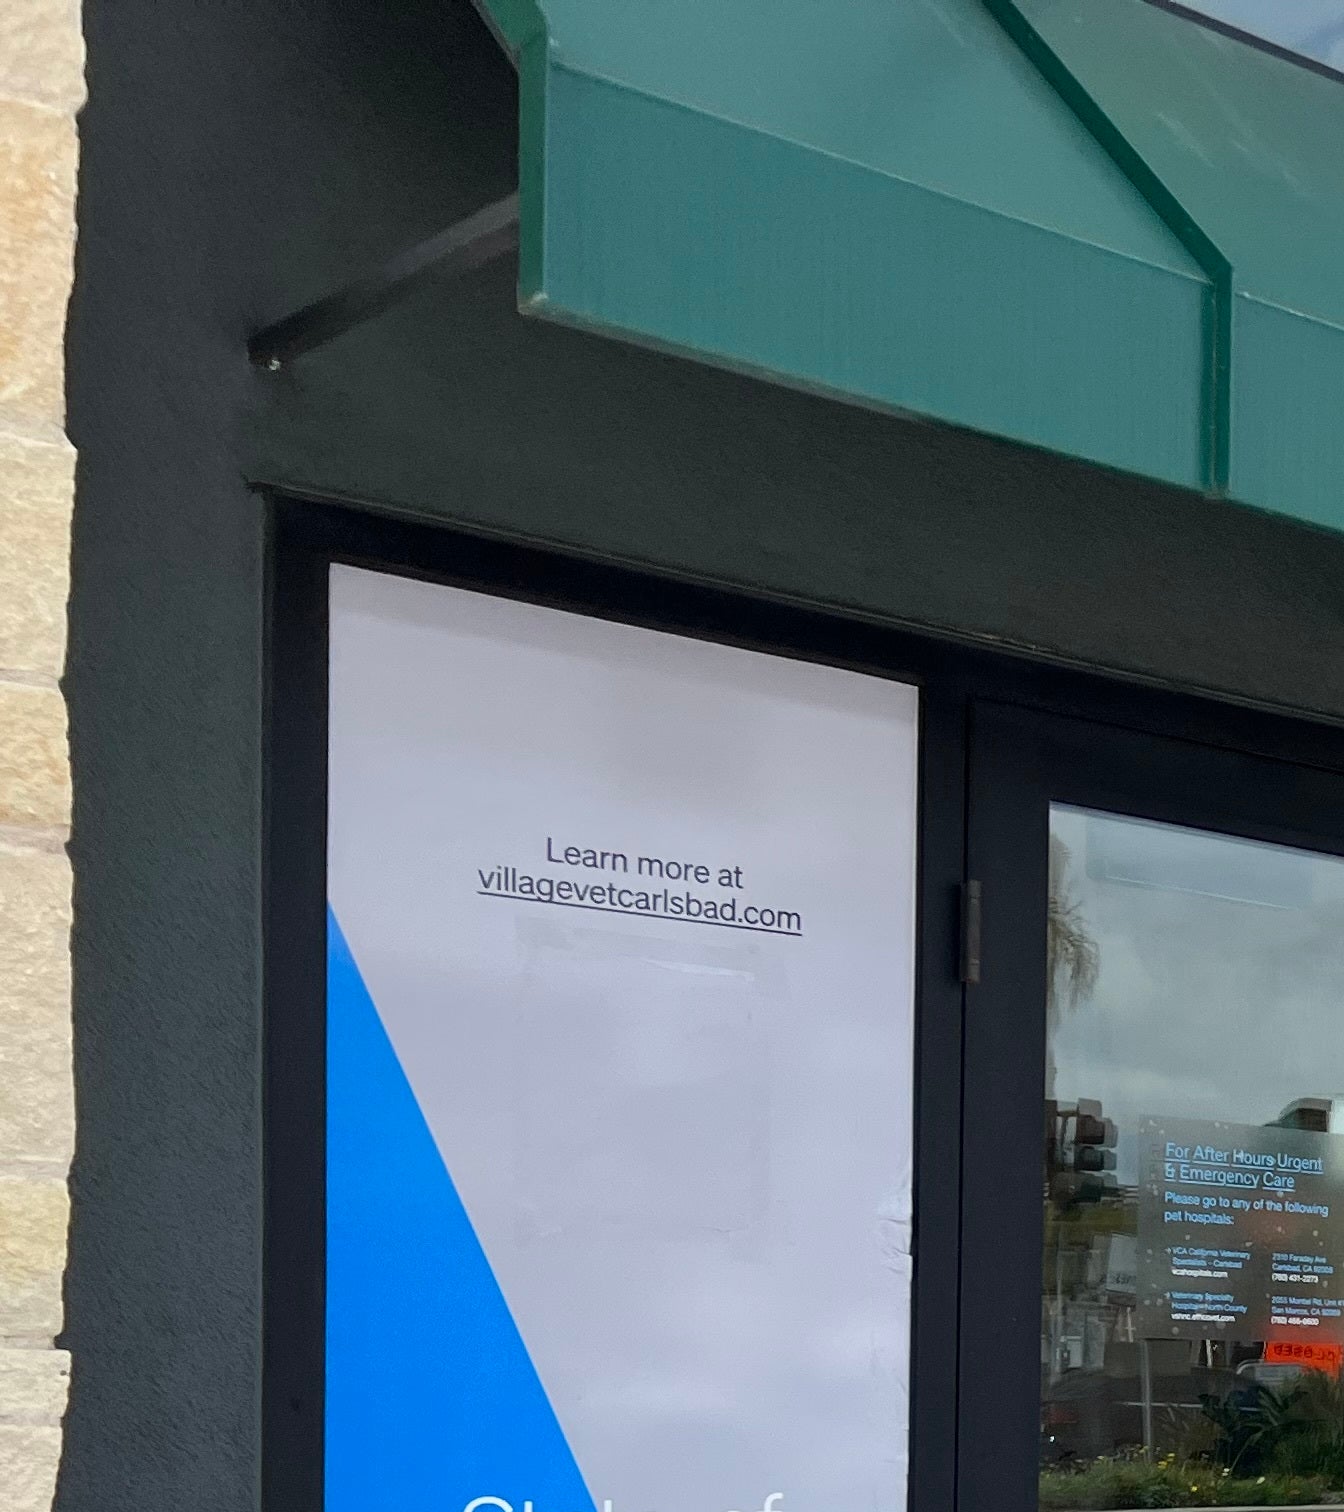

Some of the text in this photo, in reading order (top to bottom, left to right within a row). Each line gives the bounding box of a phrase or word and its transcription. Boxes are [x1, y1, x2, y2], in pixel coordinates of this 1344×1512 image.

[546, 837, 744, 889] Learn more at
[477, 865, 802, 935] villagevetcarlsbad.com
[1166, 1142, 1324, 1172] For After Hours Urgent
[1165, 1163, 1295, 1189] & Emergency Care
[1164, 1210, 1235, 1226] pet hospitals:
[1165, 1191, 1329, 1217] Please go to any of the following
